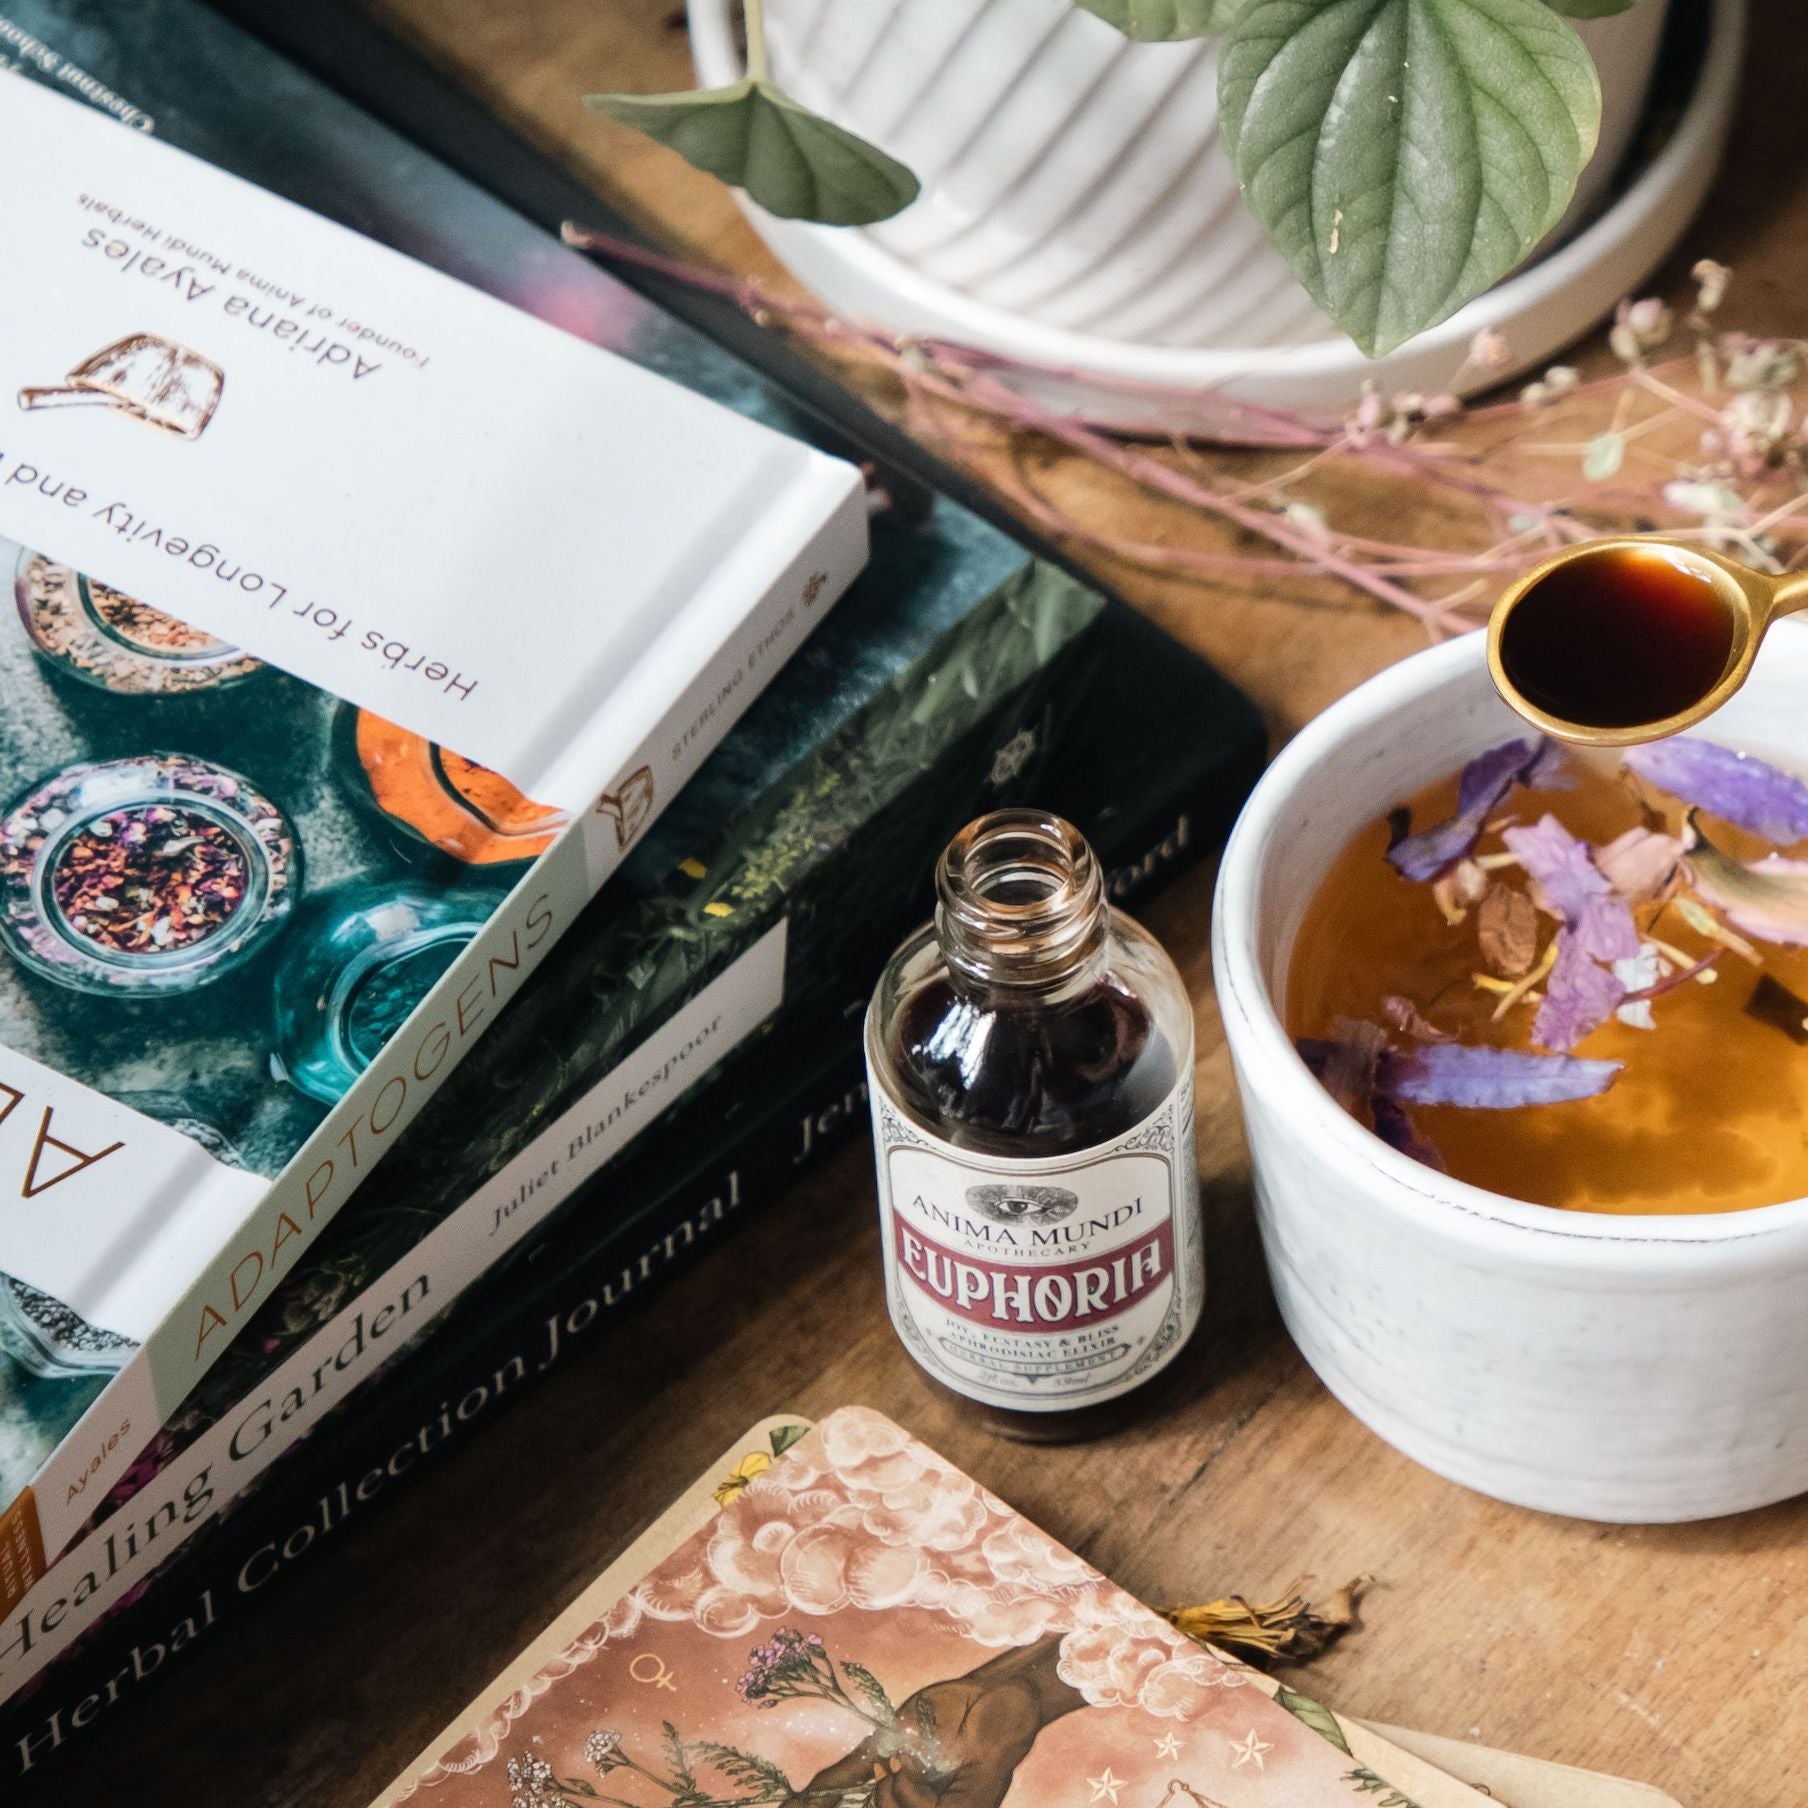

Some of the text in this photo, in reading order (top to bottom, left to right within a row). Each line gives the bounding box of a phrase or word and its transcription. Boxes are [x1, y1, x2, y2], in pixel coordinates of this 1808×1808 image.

[77, 192, 430, 368] Founder of Anima Mundi Herbals
[81, 227, 382, 380] Adriana Ayales
[4, 463, 479, 702] Herbs for Longevity and
[195, 894, 553, 1362] ADAPTOGENS
[489, 1015, 721, 1237] Juliet Blankespoor
[901, 1226, 1162, 1323] EUPHORIA
[912, 1195, 1144, 1245] ANIMA MUNDI
[963, 1239, 1092, 1258] APOTHECARY
[229, 1274, 430, 1461] Garden
[1059, 1338, 1071, 1348] &
[15, 1589, 218, 1776] Herbal
[237, 1354, 526, 1593] Collection
[538, 1170, 742, 1371] Journal
[67, 1419, 131, 1507] Ayales
